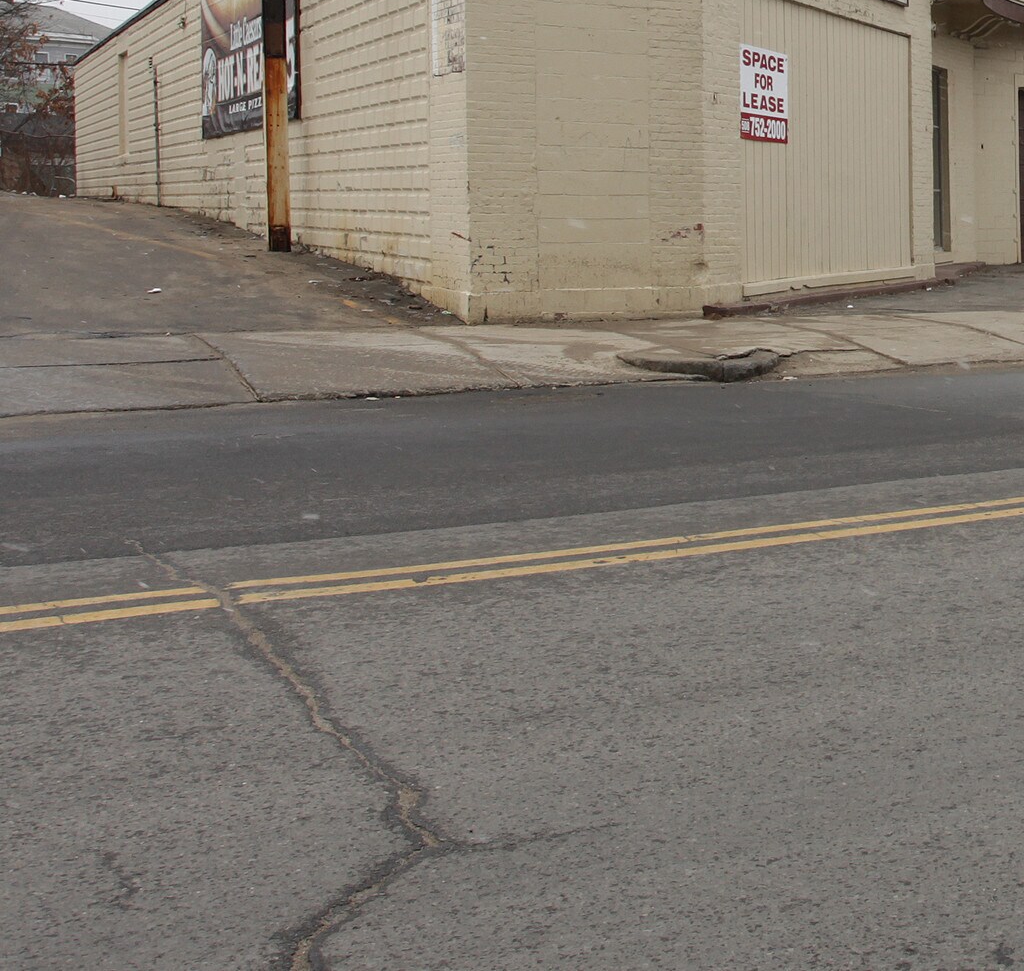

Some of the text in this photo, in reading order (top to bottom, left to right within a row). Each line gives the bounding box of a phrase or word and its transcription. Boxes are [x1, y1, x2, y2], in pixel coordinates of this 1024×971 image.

[742, 49, 784, 73] SPACE
[754, 72, 773, 91] FOR
[229, 97, 262, 114] LARGE PIZZ
[743, 91, 784, 114] LEASE
[750, 116, 786, 140] 752-2000
